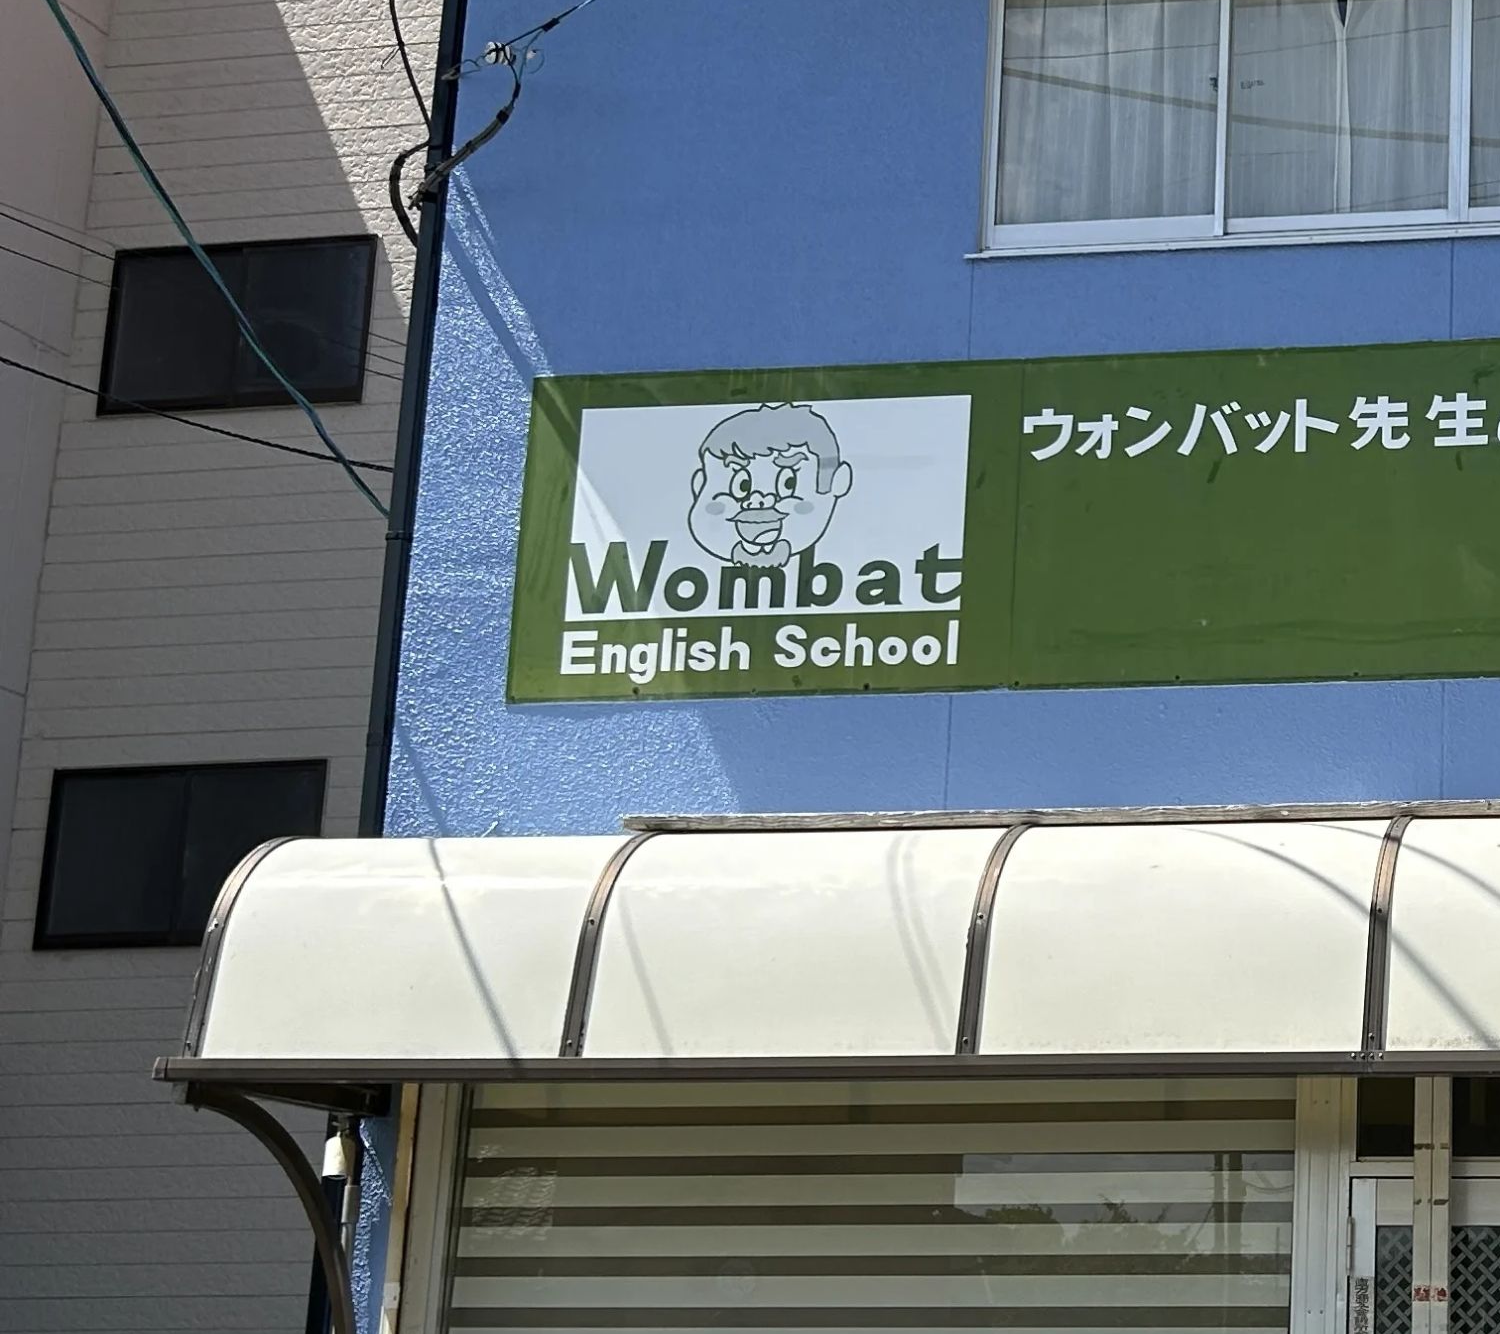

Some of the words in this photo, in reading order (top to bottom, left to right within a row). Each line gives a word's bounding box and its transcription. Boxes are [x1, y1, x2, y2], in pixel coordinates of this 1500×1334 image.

[569, 540, 963, 615] Wombat
[559, 626, 751, 685] English
[774, 619, 960, 668] School
